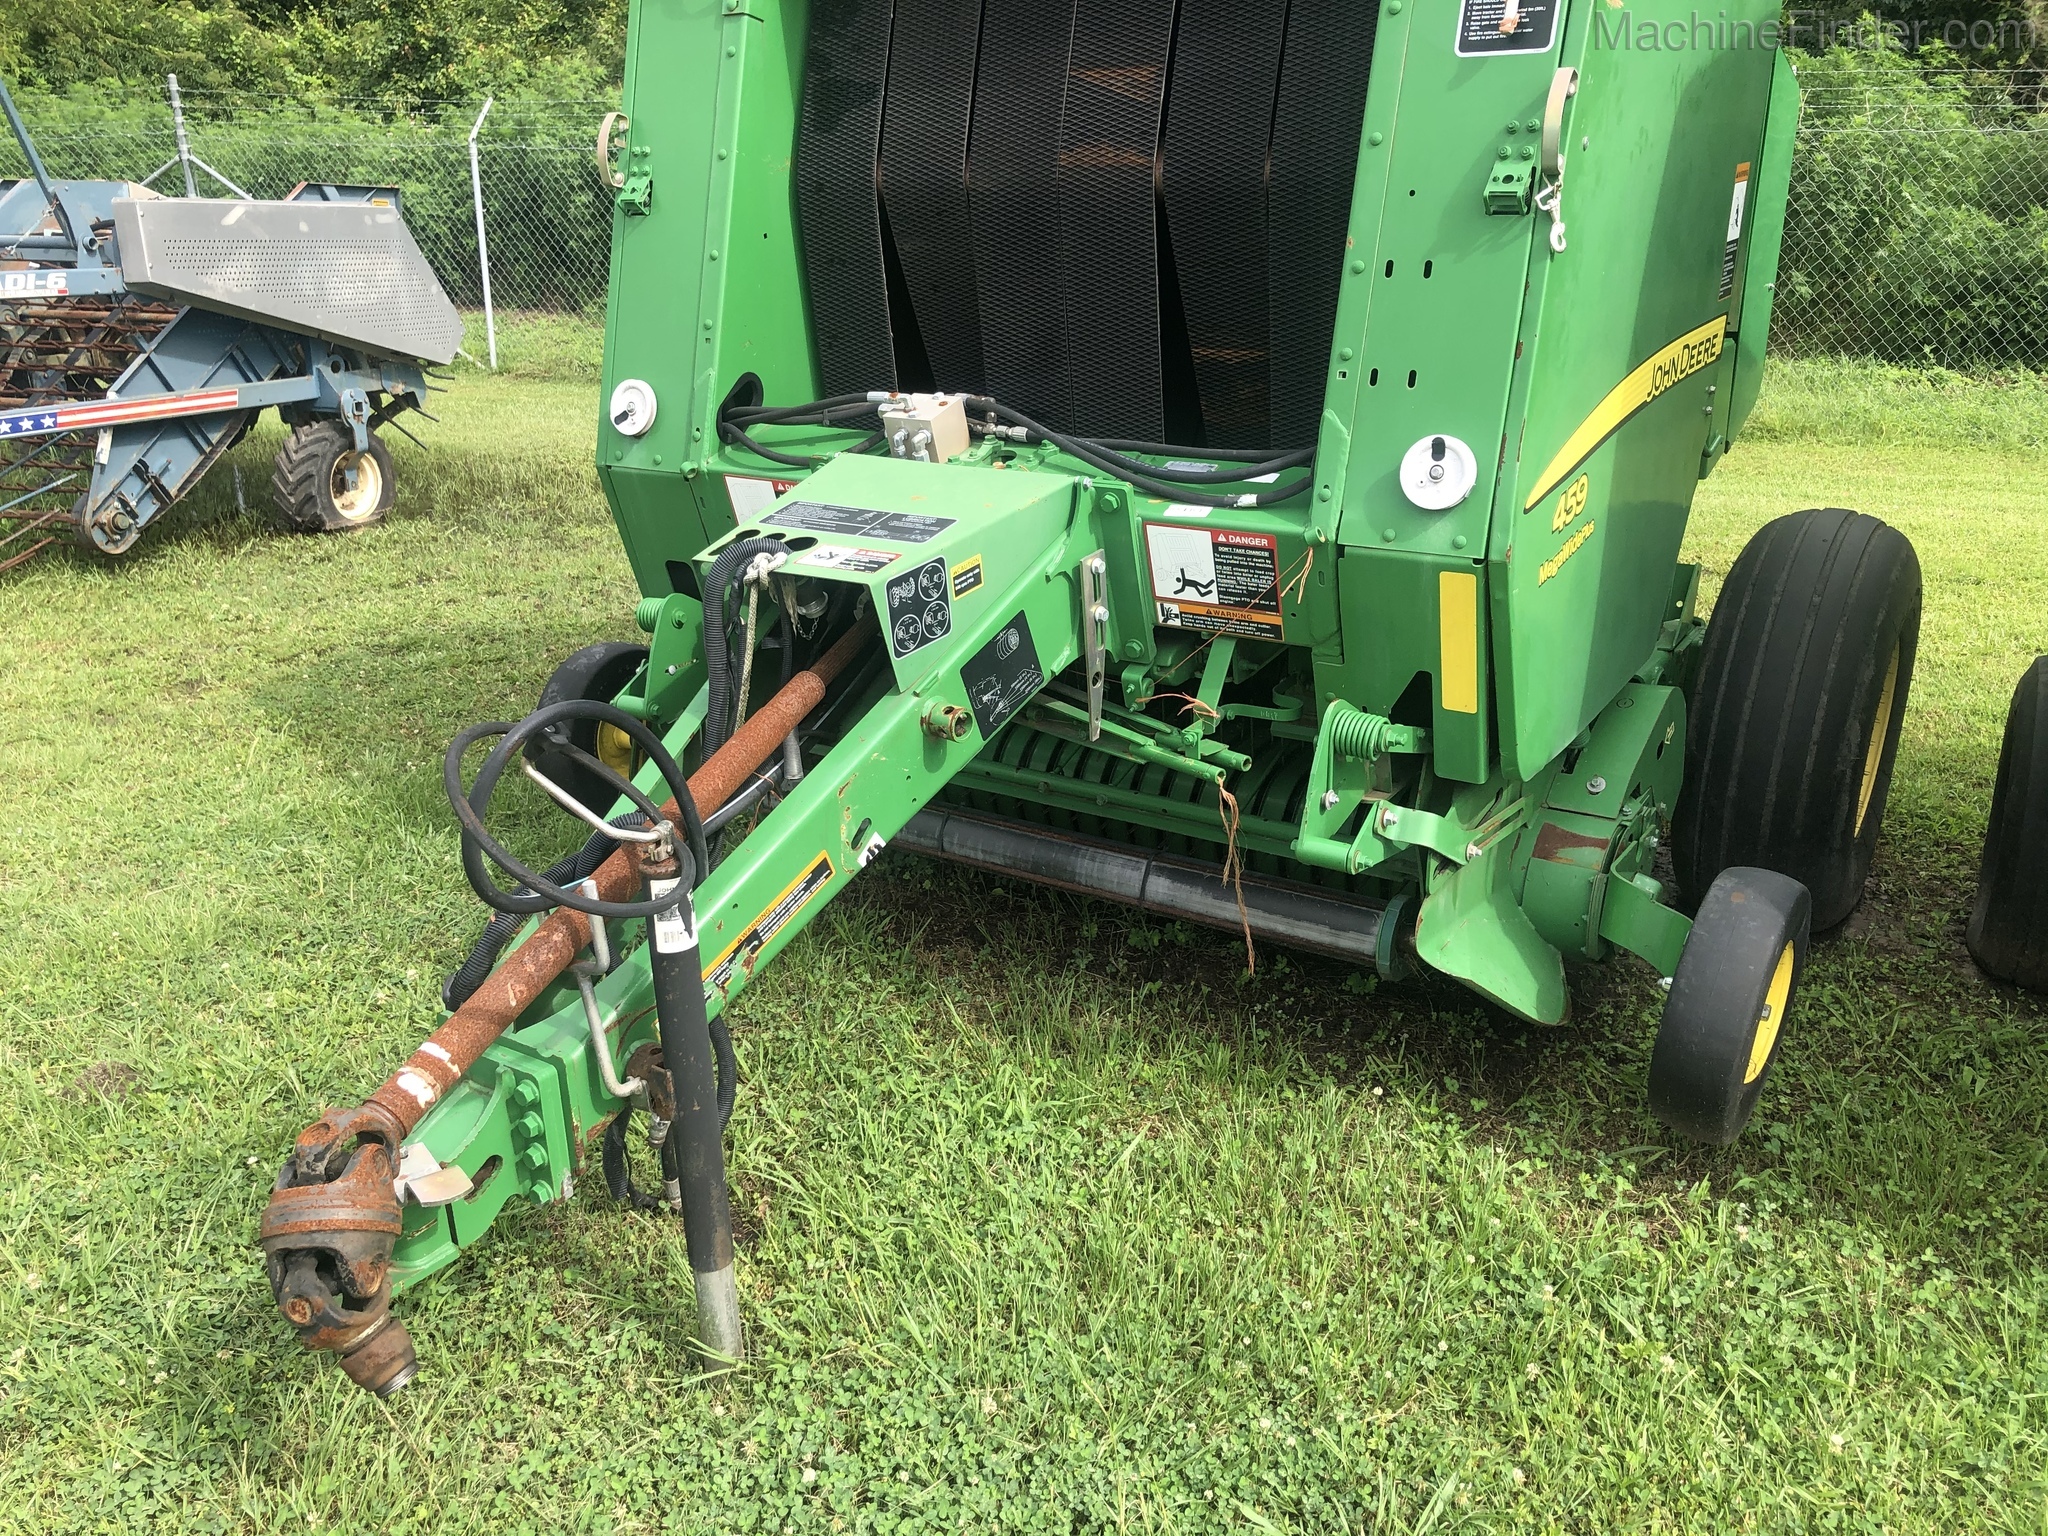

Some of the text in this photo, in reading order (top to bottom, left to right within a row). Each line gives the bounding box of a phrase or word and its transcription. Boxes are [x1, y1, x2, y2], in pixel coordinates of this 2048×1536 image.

[1646, 333, 1719, 398] JOHN DEERE
[1551, 472, 1588, 534] 459
[1228, 534, 1268, 547] DANGER
[956, 558, 980, 573] CAUTION
[1212, 609, 1253, 620] WARNING
[742, 908, 771, 939] WARNING
